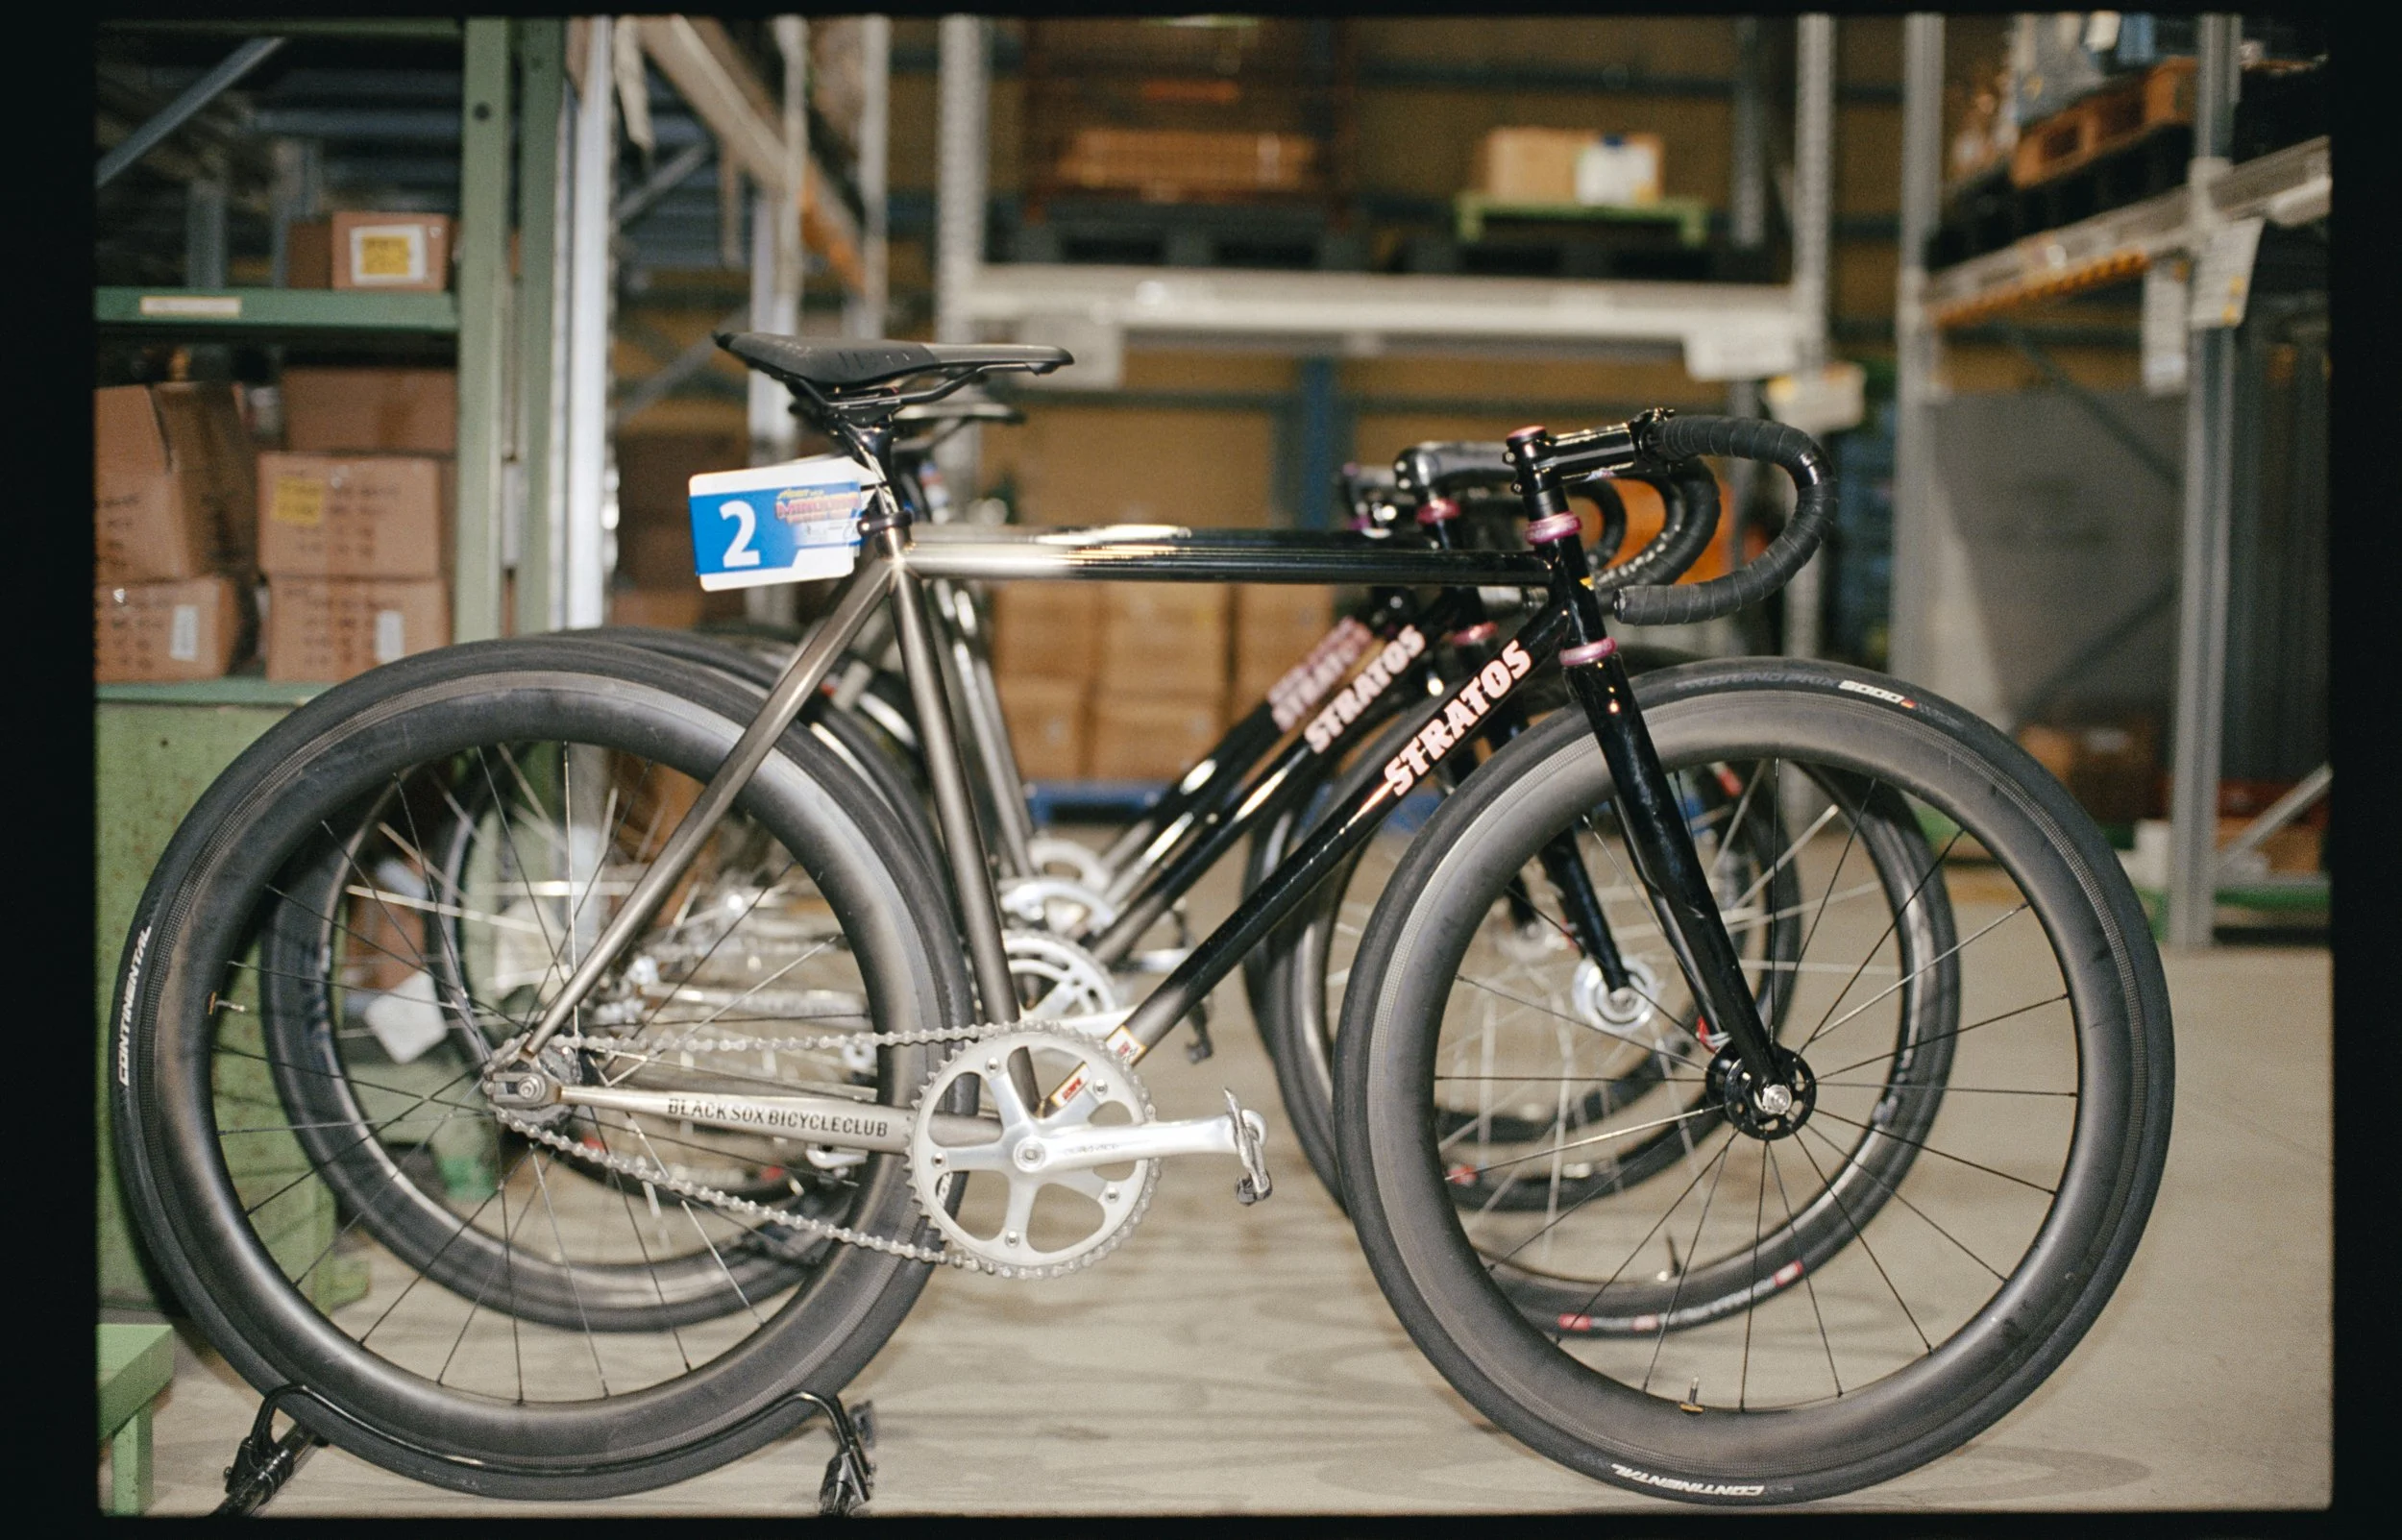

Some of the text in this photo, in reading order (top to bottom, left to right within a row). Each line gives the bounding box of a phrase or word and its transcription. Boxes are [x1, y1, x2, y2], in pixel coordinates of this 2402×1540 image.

[719, 499, 761, 569] 2
[1304, 624, 1427, 755] STRATOS
[1384, 638, 1532, 797] STRATOS
[117, 925, 153, 1087] CONTINENTAL
[667, 1098, 727, 1121] BLACK
[730, 1105, 766, 1125] SOX
[1611, 1463, 1764, 1496] CONTINENTAL
